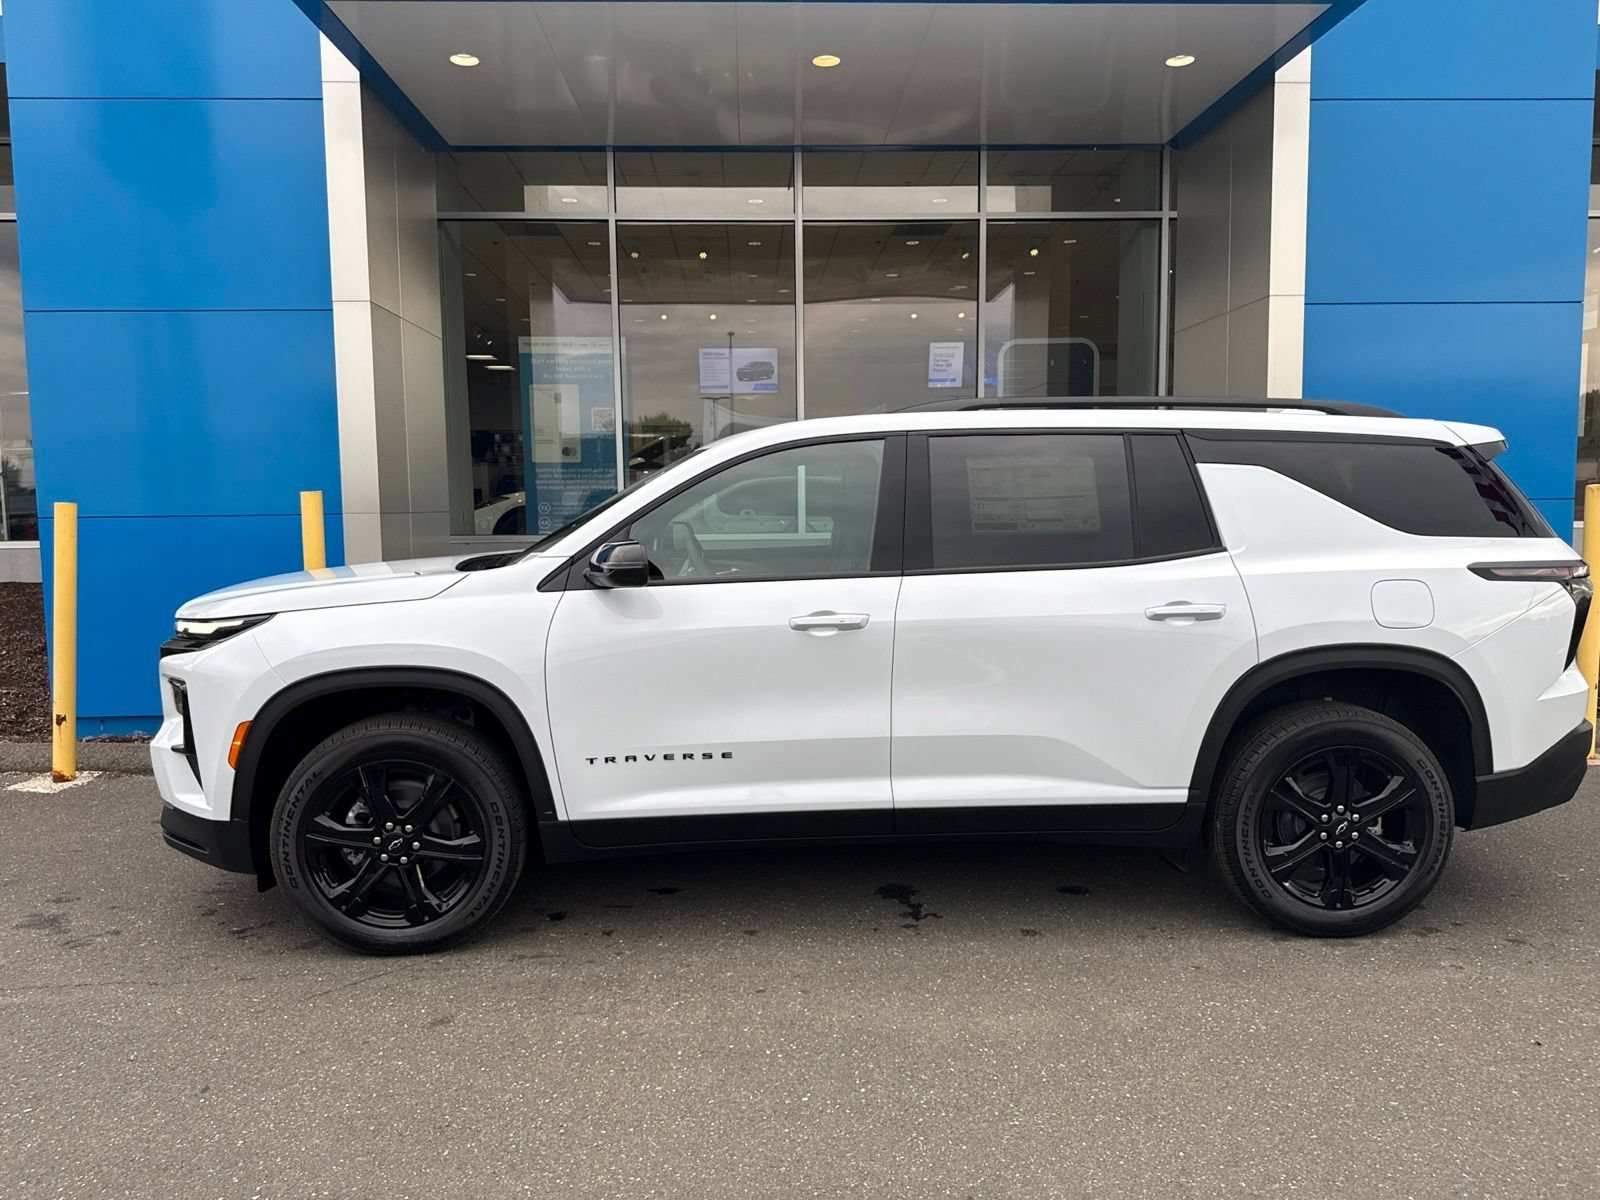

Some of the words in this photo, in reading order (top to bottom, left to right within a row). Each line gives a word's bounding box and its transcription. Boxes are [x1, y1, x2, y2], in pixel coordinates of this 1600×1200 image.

[585, 752, 734, 765] TRAVERSE
[282, 771, 322, 889] CONTINENTAL
[465, 802, 506, 919] CONTINENTAL
[1241, 787, 1272, 898] CONTINENTAL
[1417, 759, 1446, 873] CONTINENTAL
